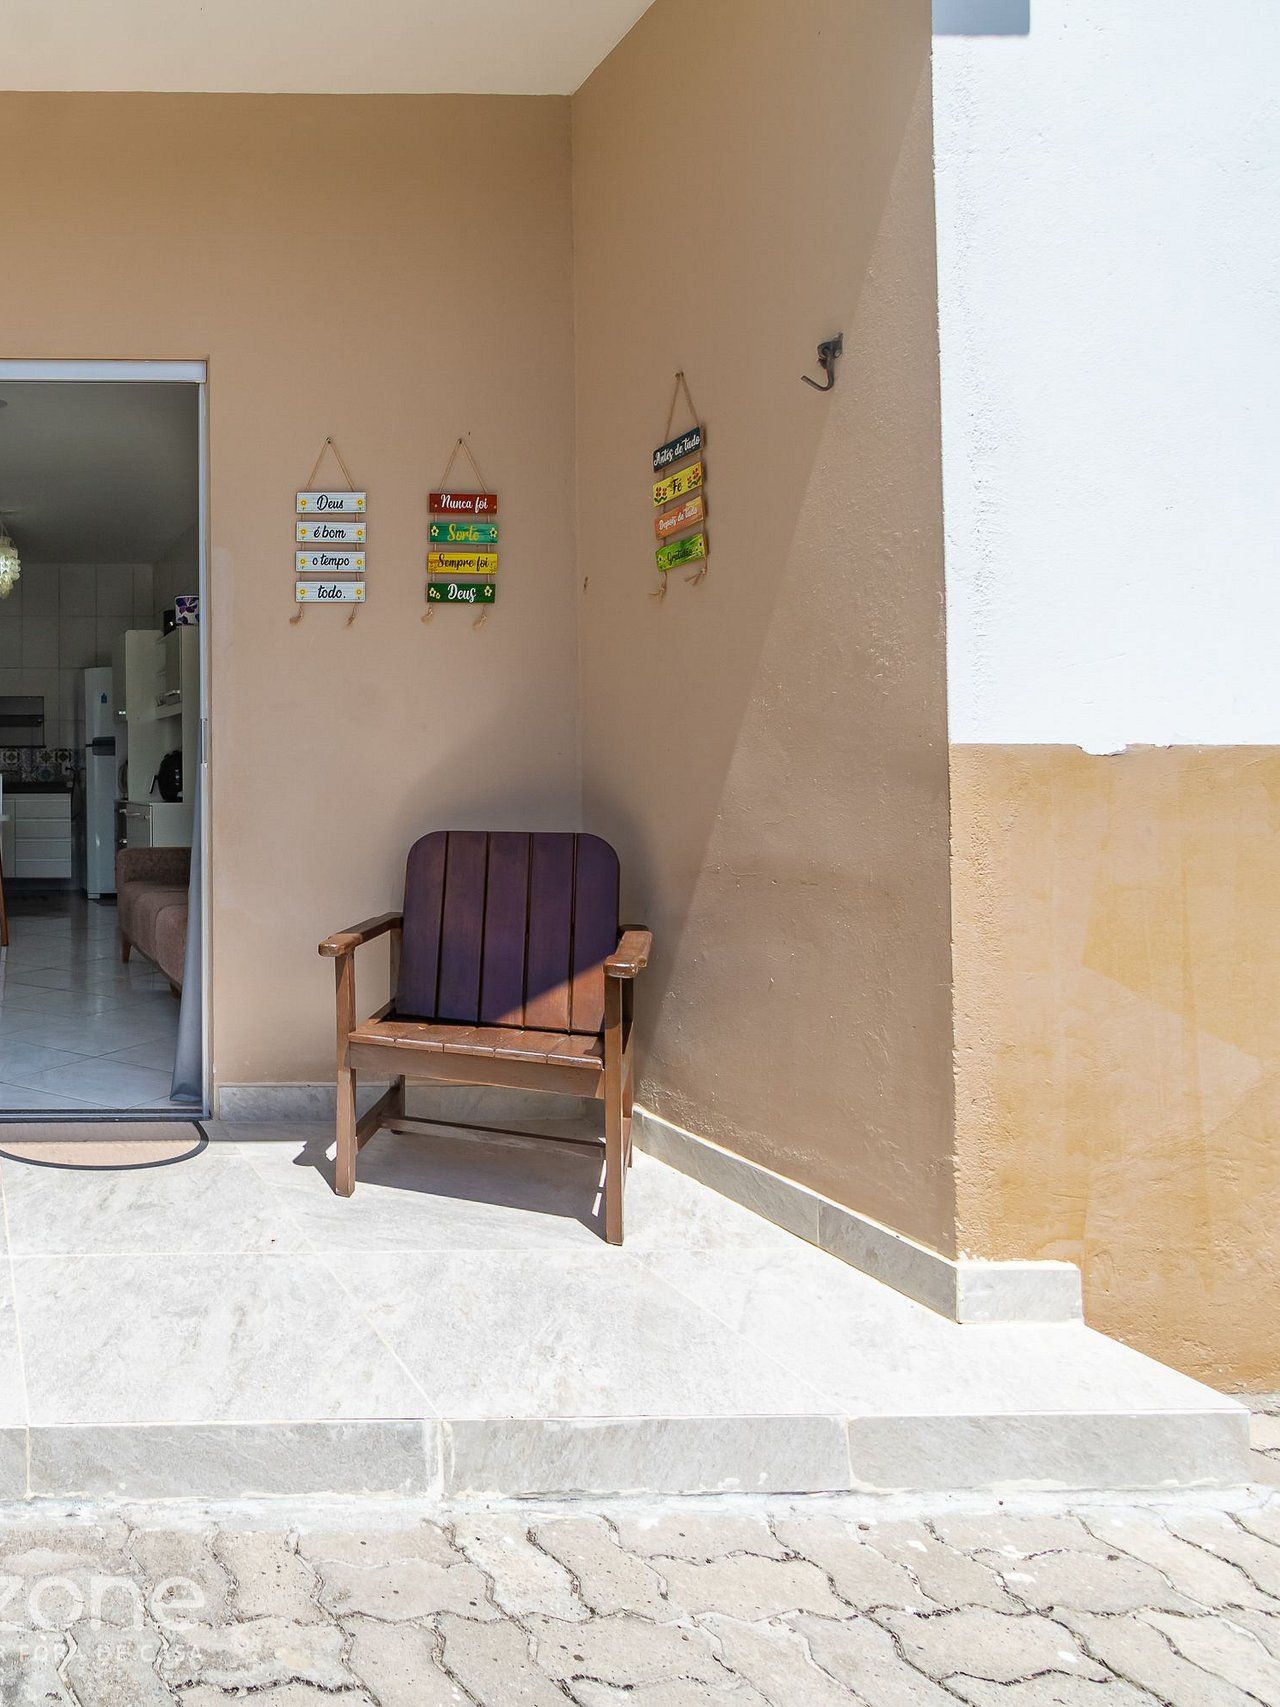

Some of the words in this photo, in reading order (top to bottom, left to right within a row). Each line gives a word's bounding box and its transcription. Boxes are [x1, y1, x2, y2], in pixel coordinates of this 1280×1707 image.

[653, 447, 674, 466] Antes
[674, 443, 683, 455] de
[671, 477, 683, 495] Fé
[316, 494, 344, 511] Deus
[440, 494, 473, 509] Nunca
[474, 497, 489, 513] foi
[313, 526, 321, 538] é
[322, 525, 347, 539] bom
[447, 523, 480, 541] Sorte
[312, 557, 318, 566] o
[320, 553, 350, 570] tempo
[437, 553, 474, 570] Sempre
[476, 556, 489, 572] foi
[447, 583, 477, 603] Deus
